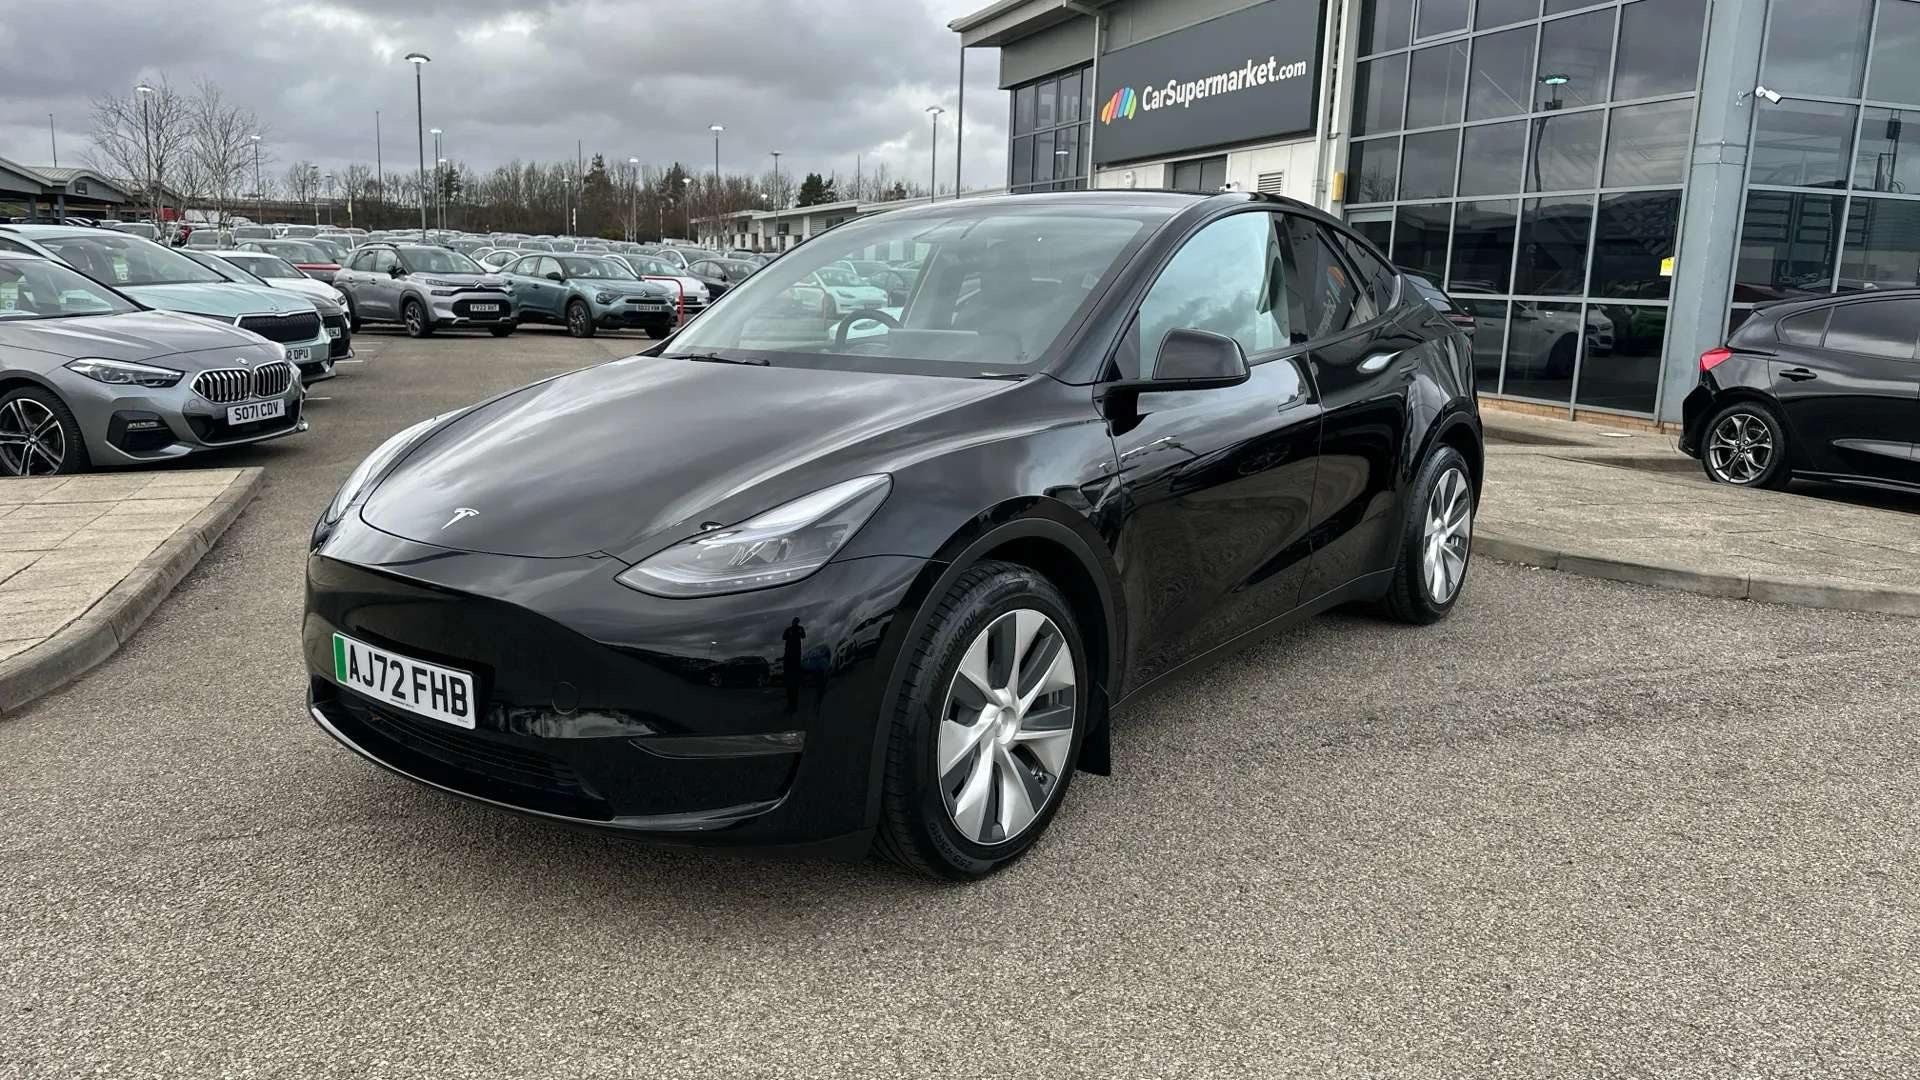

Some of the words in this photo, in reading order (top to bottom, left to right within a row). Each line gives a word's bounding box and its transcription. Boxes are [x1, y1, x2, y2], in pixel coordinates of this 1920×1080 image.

[1143, 56, 1306, 111] CarSupermarket.com
[234, 406, 259, 421] SO71
[260, 402, 279, 416] CDV
[350, 644, 406, 700] AJ72
[411, 666, 468, 718] FHB
